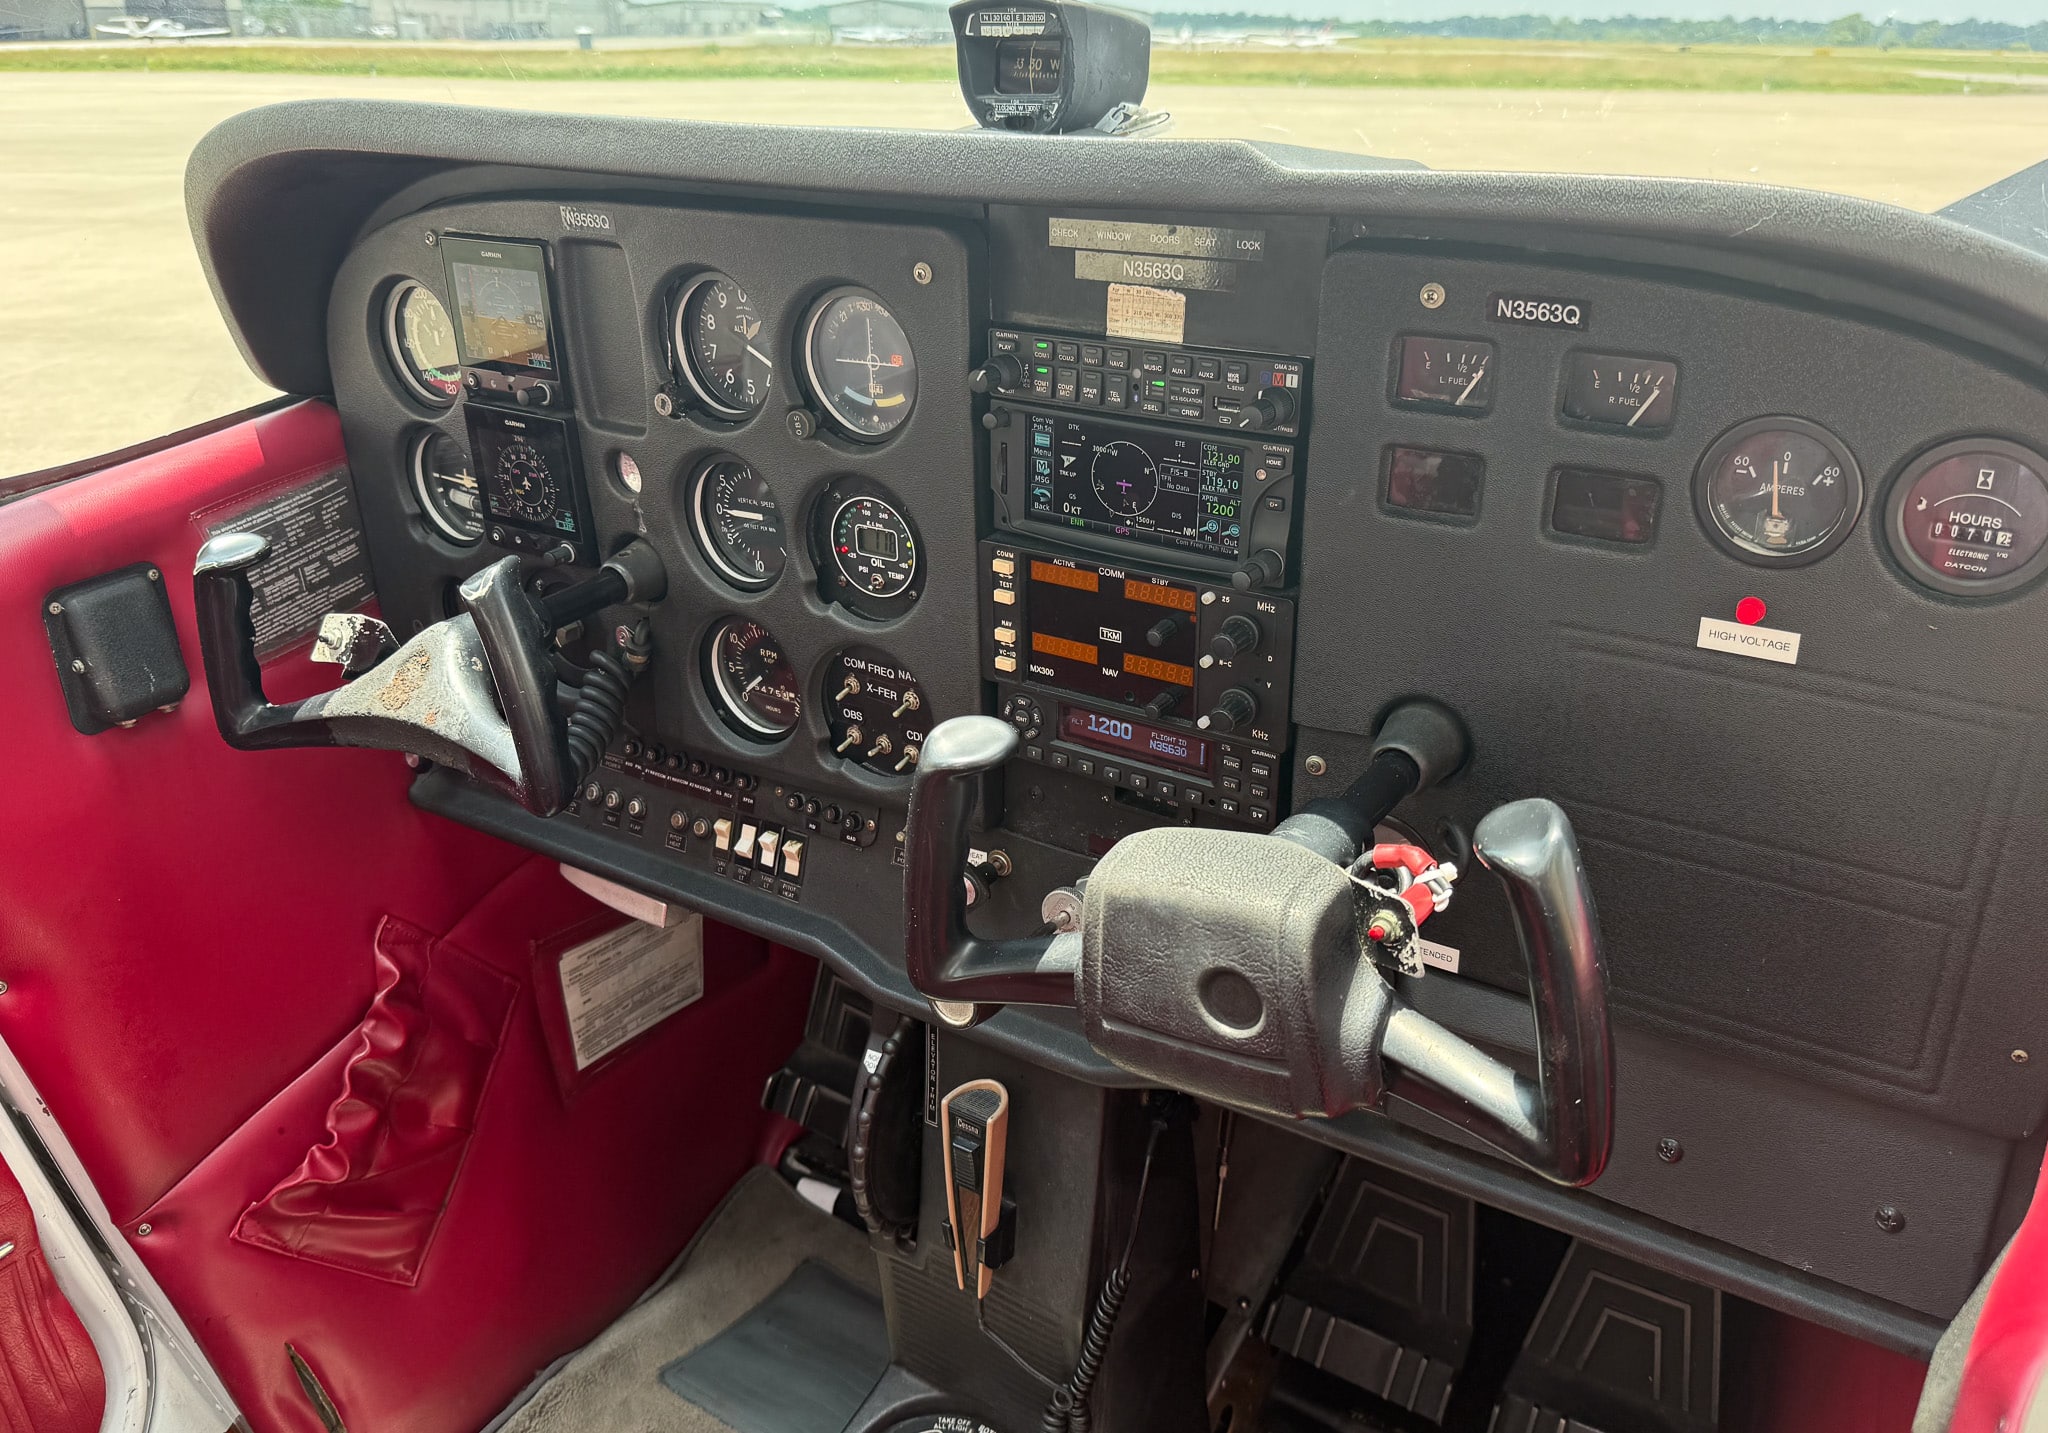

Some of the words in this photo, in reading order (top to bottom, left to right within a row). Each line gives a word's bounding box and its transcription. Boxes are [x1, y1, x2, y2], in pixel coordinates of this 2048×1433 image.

[1050, 59, 1060, 70] W
[1052, 228, 1079, 238] CHECK
[1096, 231, 1132, 241] WINDOW
[1150, 234, 1180, 245] DOORS
[1194, 237, 1217, 247] SEAT
[1236, 240, 1261, 250] LOCK
[1122, 260, 1185, 282] N3563Q
[718, 292, 728, 309] 9
[1497, 299, 1580, 325] N3563Q
[707, 314, 716, 330] 8
[995, 331, 1019, 340] GARMIN
[709, 343, 717, 360] 7
[998, 343, 1012, 351] PLAY
[1034, 351, 1050, 359] COM1
[1058, 354, 1075, 362] COM2
[1084, 357, 1099, 365] NAV1
[1109, 360, 1125, 368] NAV2
[1143, 364, 1162, 372] MUSIC
[1198, 371, 1215, 379] AUX2
[1425, 361, 1431, 369] E
[1457, 363, 1468, 373] 1/2
[726, 368, 735, 385] 6
[1274, 374, 1283, 385] M
[1448, 377, 1469, 386] FUEL
[747, 379, 756, 395] 5
[1034, 379, 1049, 388] COM1
[1058, 383, 1074, 391] COM2
[1594, 381, 1600, 389] E
[1629, 383, 1640, 394] 1/2
[1083, 387, 1097, 395] SPKR
[1110, 390, 1120, 398] TEL
[1182, 387, 1200, 395] PILOT
[1618, 397, 1640, 407] FUEL
[1181, 408, 1200, 417] CREW
[505, 420, 526, 429] GARMIN
[1033, 423, 1044, 431] Psh
[1068, 423, 1080, 431] DTK
[1175, 440, 1186, 448] ETE
[1203, 443, 1218, 452] COM
[1262, 444, 1290, 454] GARMIN
[1033, 447, 1052, 457] Menu
[1207, 450, 1241, 465] 121.90
[1203, 459, 1217, 467] KLEX
[1217, 461, 1230, 469] GND
[1734, 456, 1750, 466] 60
[1784, 451, 1792, 461] 0
[1823, 466, 1840, 477] 60
[1059, 469, 1069, 477] TRK
[1144, 467, 1150, 475] N
[1170, 467, 1189, 477] FIS-B
[1202, 469, 1217, 477] STBY
[719, 474, 726, 486] 5
[1034, 475, 1050, 484] MSG
[1205, 475, 1239, 490] 119.10
[1166, 483, 1175, 491] No
[1175, 484, 1190, 493] Data
[1201, 485, 1215, 493] KLEX
[1216, 486, 1229, 494] TWR
[1760, 482, 1805, 496] AMPERES
[1034, 501, 1050, 512] Back
[1132, 501, 1137, 509] E
[1201, 495, 1218, 503] XPDR
[1229, 499, 1241, 507] ALT
[716, 503, 723, 515] 0
[1063, 502, 1070, 513] 0
[1071, 506, 1082, 516] KT
[1206, 502, 1234, 517] 1200
[1135, 516, 1150, 525] 1500
[1171, 512, 1182, 520] DIS
[1948, 511, 2002, 529] HOURS
[1070, 517, 1084, 527] ENR
[1115, 526, 1130, 536] GPS
[1183, 526, 1196, 537] NM
[727, 533, 734, 545] 5
[1205, 534, 1212, 542] In
[1223, 538, 1238, 547] Out
[1175, 538, 1189, 546] Com
[1221, 546, 1232, 554] Nav
[996, 550, 1014, 559] COMM
[1948, 548, 1990, 560] ELECTRONIC
[755, 560, 765, 573] 10
[870, 558, 886, 569] OIL
[1053, 558, 1076, 569] ACTIVE
[1944, 561, 1988, 573] DATCON
[858, 565, 869, 574] PSI
[1098, 567, 1125, 579] COMM
[887, 571, 906, 581] TEMP
[1000, 580, 1013, 589] TEST
[1151, 577, 1169, 587] STBY
[1256, 601, 1276, 614] MHz
[1001, 620, 1013, 628] NAV
[1102, 629, 1120, 641] TKM
[1708, 629, 1737, 642] HIGH
[1739, 635, 1791, 652] VOLTAGE
[760, 648, 777, 660] RPM
[728, 661, 735, 673] 5
[843, 657, 866, 670] COM
[868, 663, 895, 679] FREQ
[1030, 664, 1055, 677] MX300
[1102, 667, 1119, 678] NAV
[866, 682, 897, 700] X-FER
[742, 691, 749, 703] 0
[765, 704, 782, 714] HOURS
[843, 708, 863, 721] OBS
[1071, 717, 1084, 726] ALT
[1087, 714, 1133, 740] 1200
[906, 730, 923, 742] CDI
[1151, 732, 1176, 743] FLIGHT
[1251, 728, 1269, 741] KHz
[1251, 749, 1277, 760] GARMIN
[1223, 759, 1240, 769] FUNC
[1223, 781, 1236, 789] CLR
[1252, 789, 1264, 797] ENT
[807, 803, 813, 813] 5
[782, 883, 797, 893] PITOT
[782, 890, 795, 899] HEAT
[1420, 946, 1453, 963] ENDED
[957, 1118, 979, 1135] Cessna
[938, 1416, 956, 1424] TAKE
[957, 1418, 972, 1426] OFF
